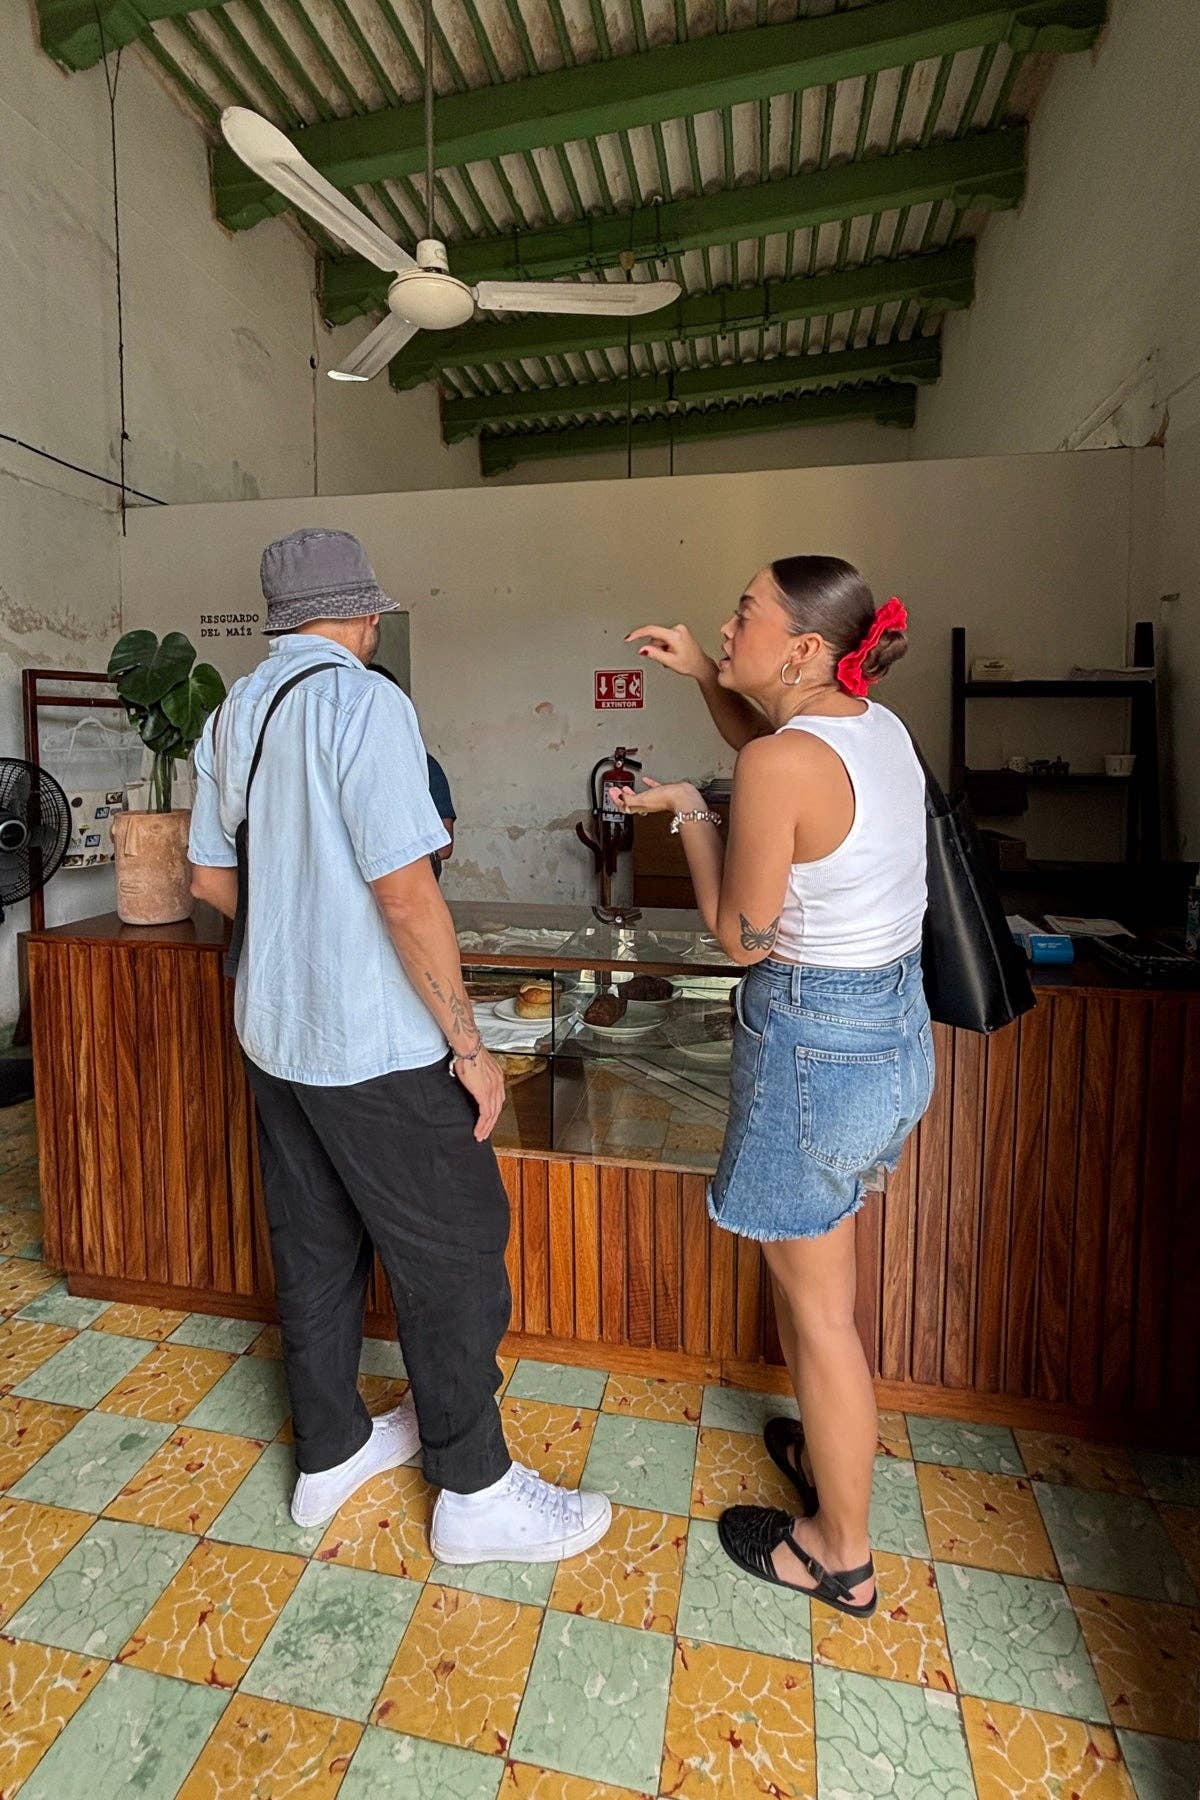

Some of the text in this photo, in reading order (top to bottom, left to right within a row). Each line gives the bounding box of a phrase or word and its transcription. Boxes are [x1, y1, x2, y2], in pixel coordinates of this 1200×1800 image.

[200, 614, 259, 624] RESGUARDO
[201, 625, 252, 637] DEL MAÍZ
